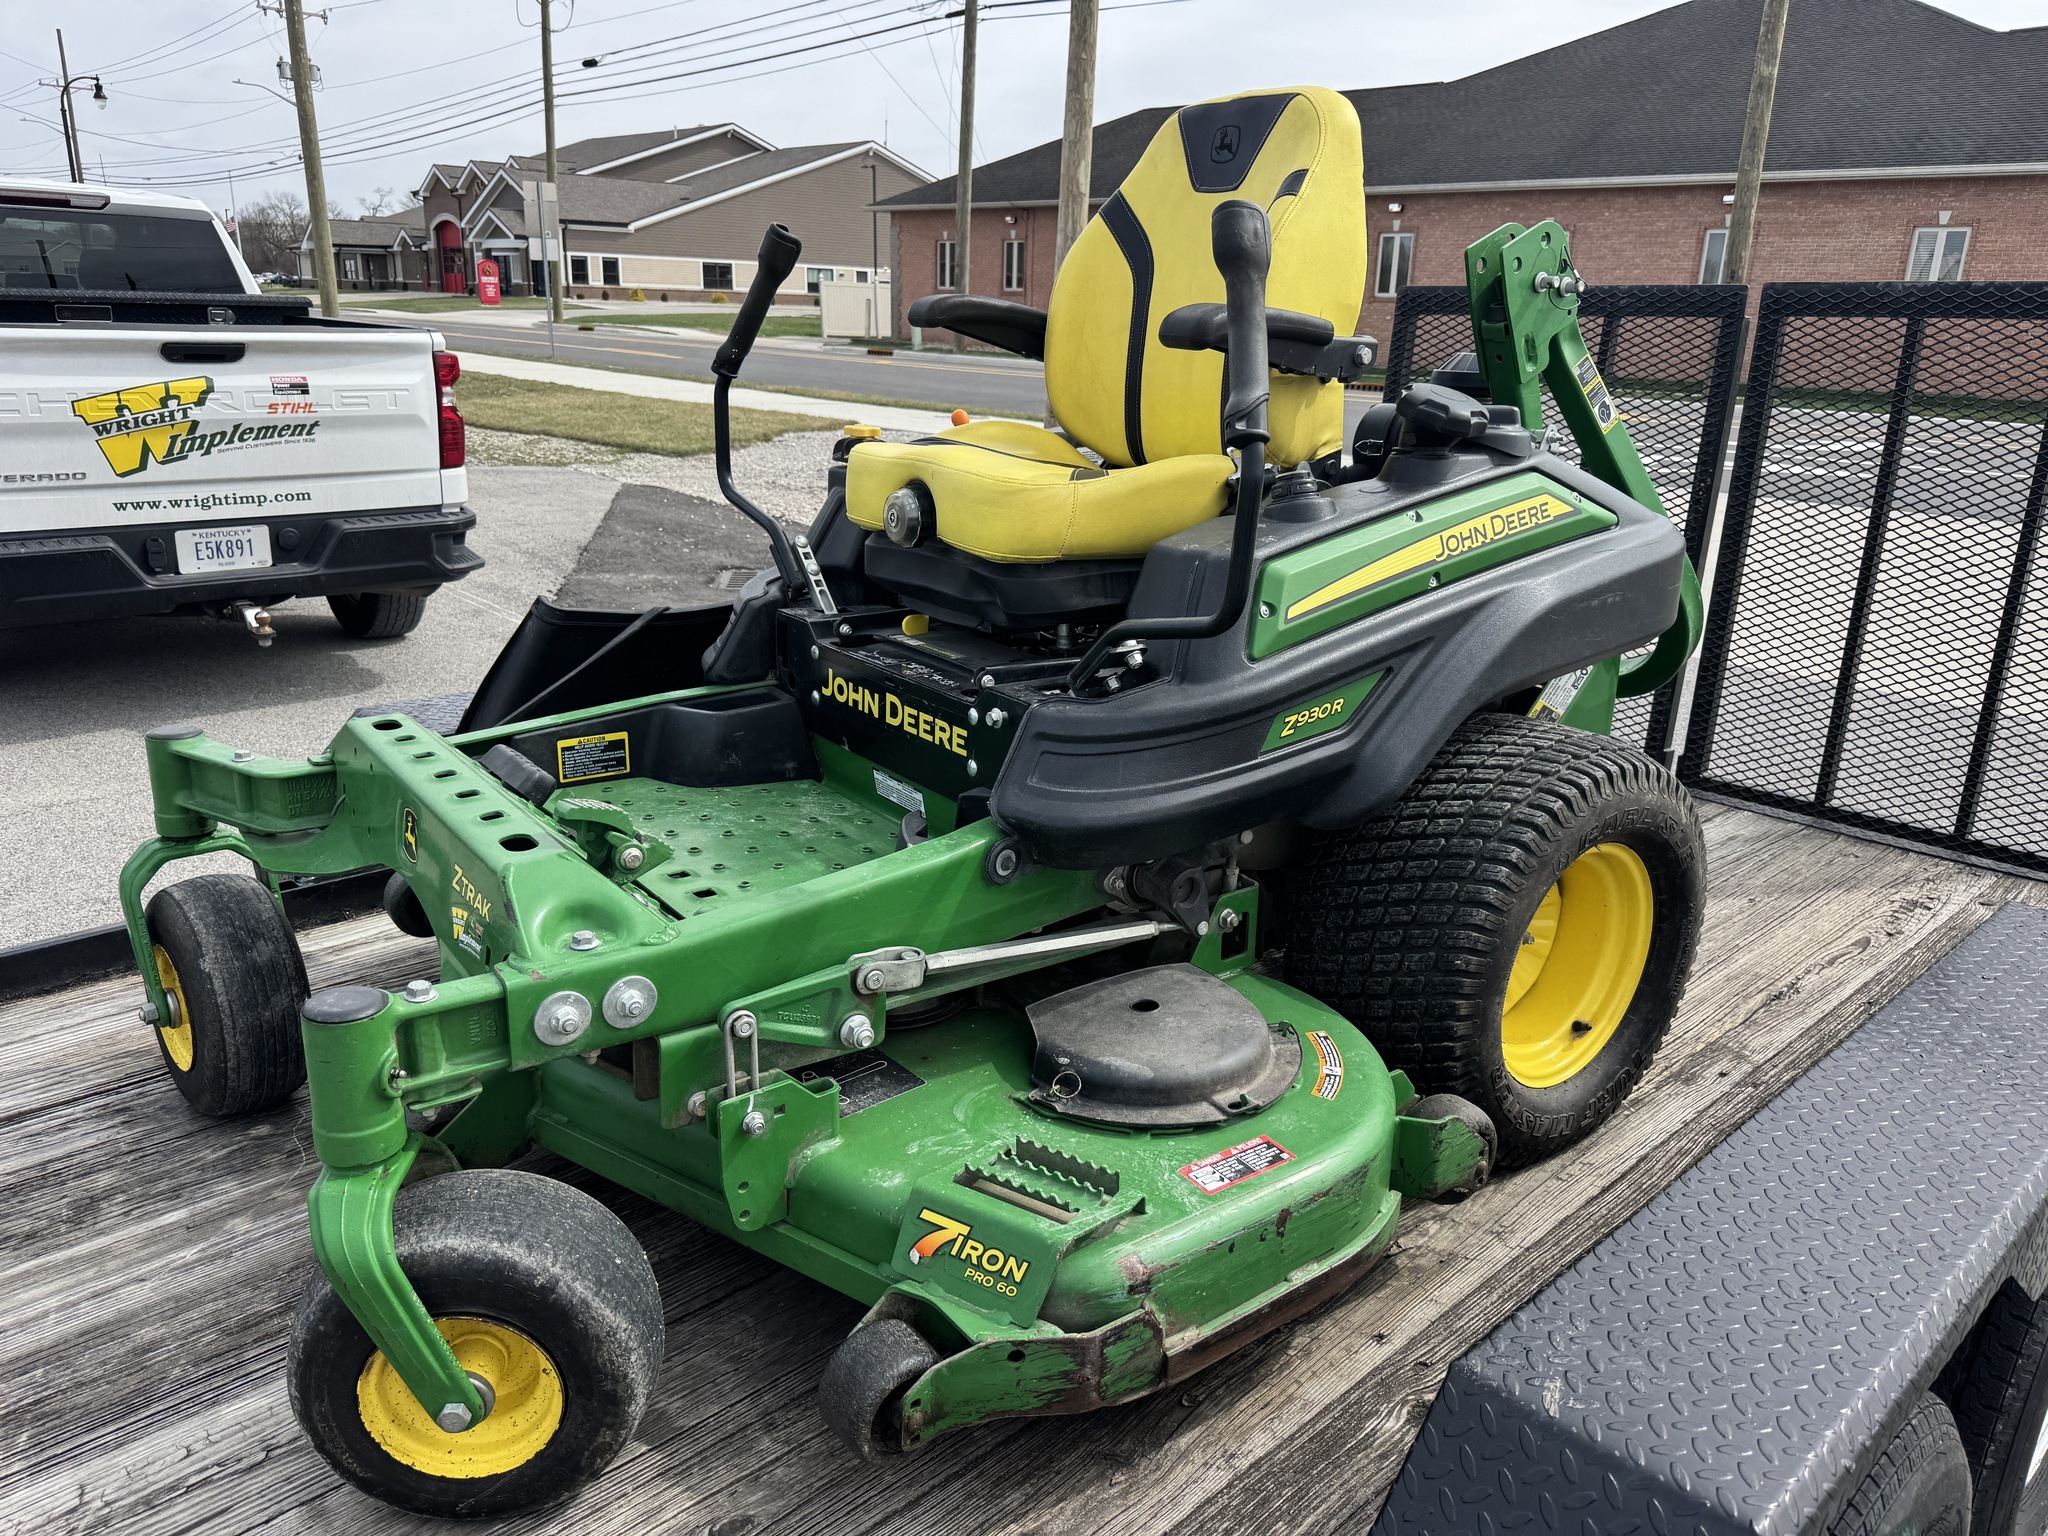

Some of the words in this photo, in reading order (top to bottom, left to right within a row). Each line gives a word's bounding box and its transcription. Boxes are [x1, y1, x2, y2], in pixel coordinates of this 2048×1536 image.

[92, 406, 193, 437] WRIGHT
[267, 402, 318, 414] STIHL
[162, 420, 320, 460] Implement
[0, 472, 86, 483] ERADO
[112, 491, 312, 511] www.wrightimp.com
[199, 529, 246, 539] KENTUCKY
[1435, 523, 1488, 559] JOHN
[1490, 502, 1551, 537] DEERE
[194, 538, 253, 561] E5K891
[821, 667, 879, 718] JOHN
[885, 692, 968, 757] DEERE
[1280, 698, 1345, 738] Z930R
[452, 863, 492, 923] ZTRAK
[1581, 1050, 1647, 1127] TURF
[963, 1267, 995, 1288] PRO
[996, 1281, 1018, 1297] 60
